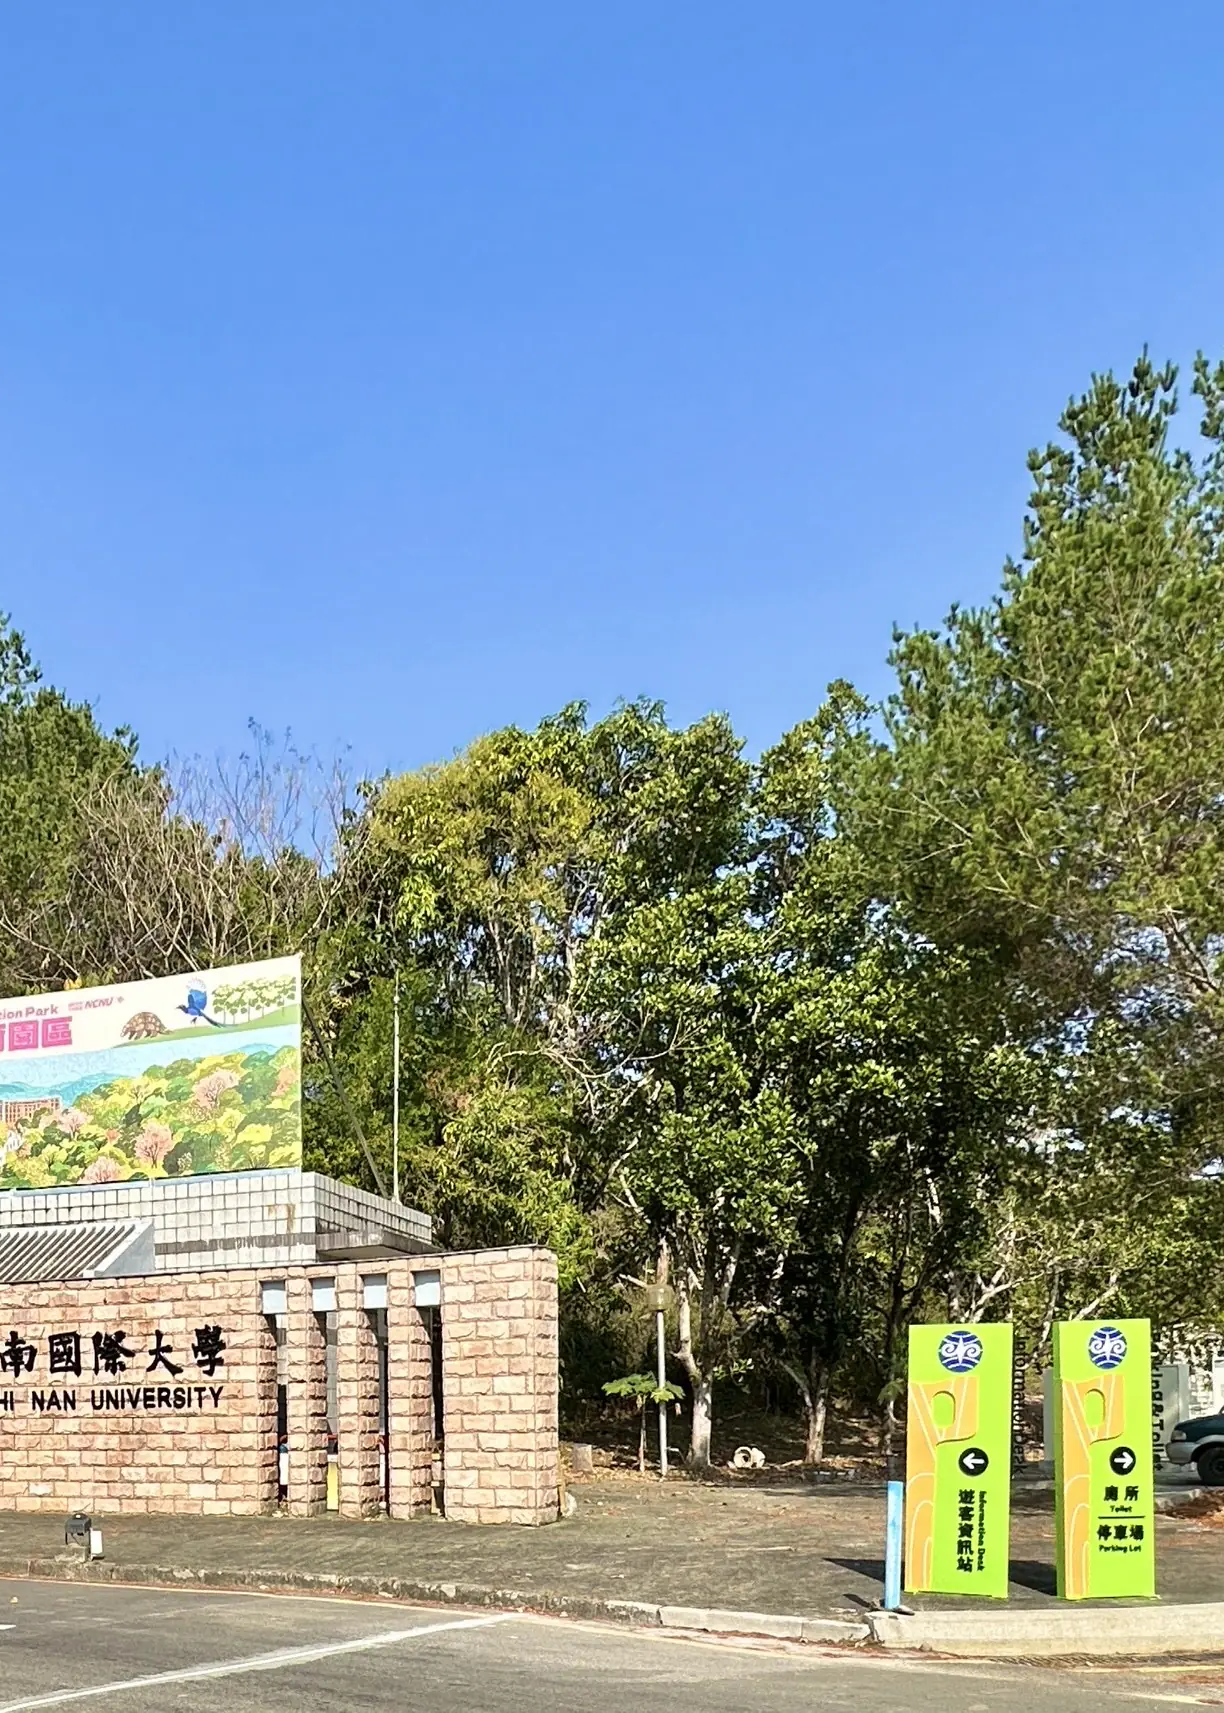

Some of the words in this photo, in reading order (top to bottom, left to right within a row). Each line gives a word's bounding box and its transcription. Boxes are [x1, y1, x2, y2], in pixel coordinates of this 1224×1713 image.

[25, 1003, 58, 1018] Park
[85, 997, 114, 1009] NCNU
[31, 1389, 77, 1412] NAN
[90, 1386, 224, 1411] UNIVERSITY
[978, 1490, 987, 1546] Information
[956, 1489, 975, 1573] 遊客資訊站
[1097, 1524, 1144, 1541] 停車場
[977, 1547, 985, 1572] Desk
[1099, 1544, 1128, 1554] Parking
[1129, 1544, 1142, 1552] Lot
